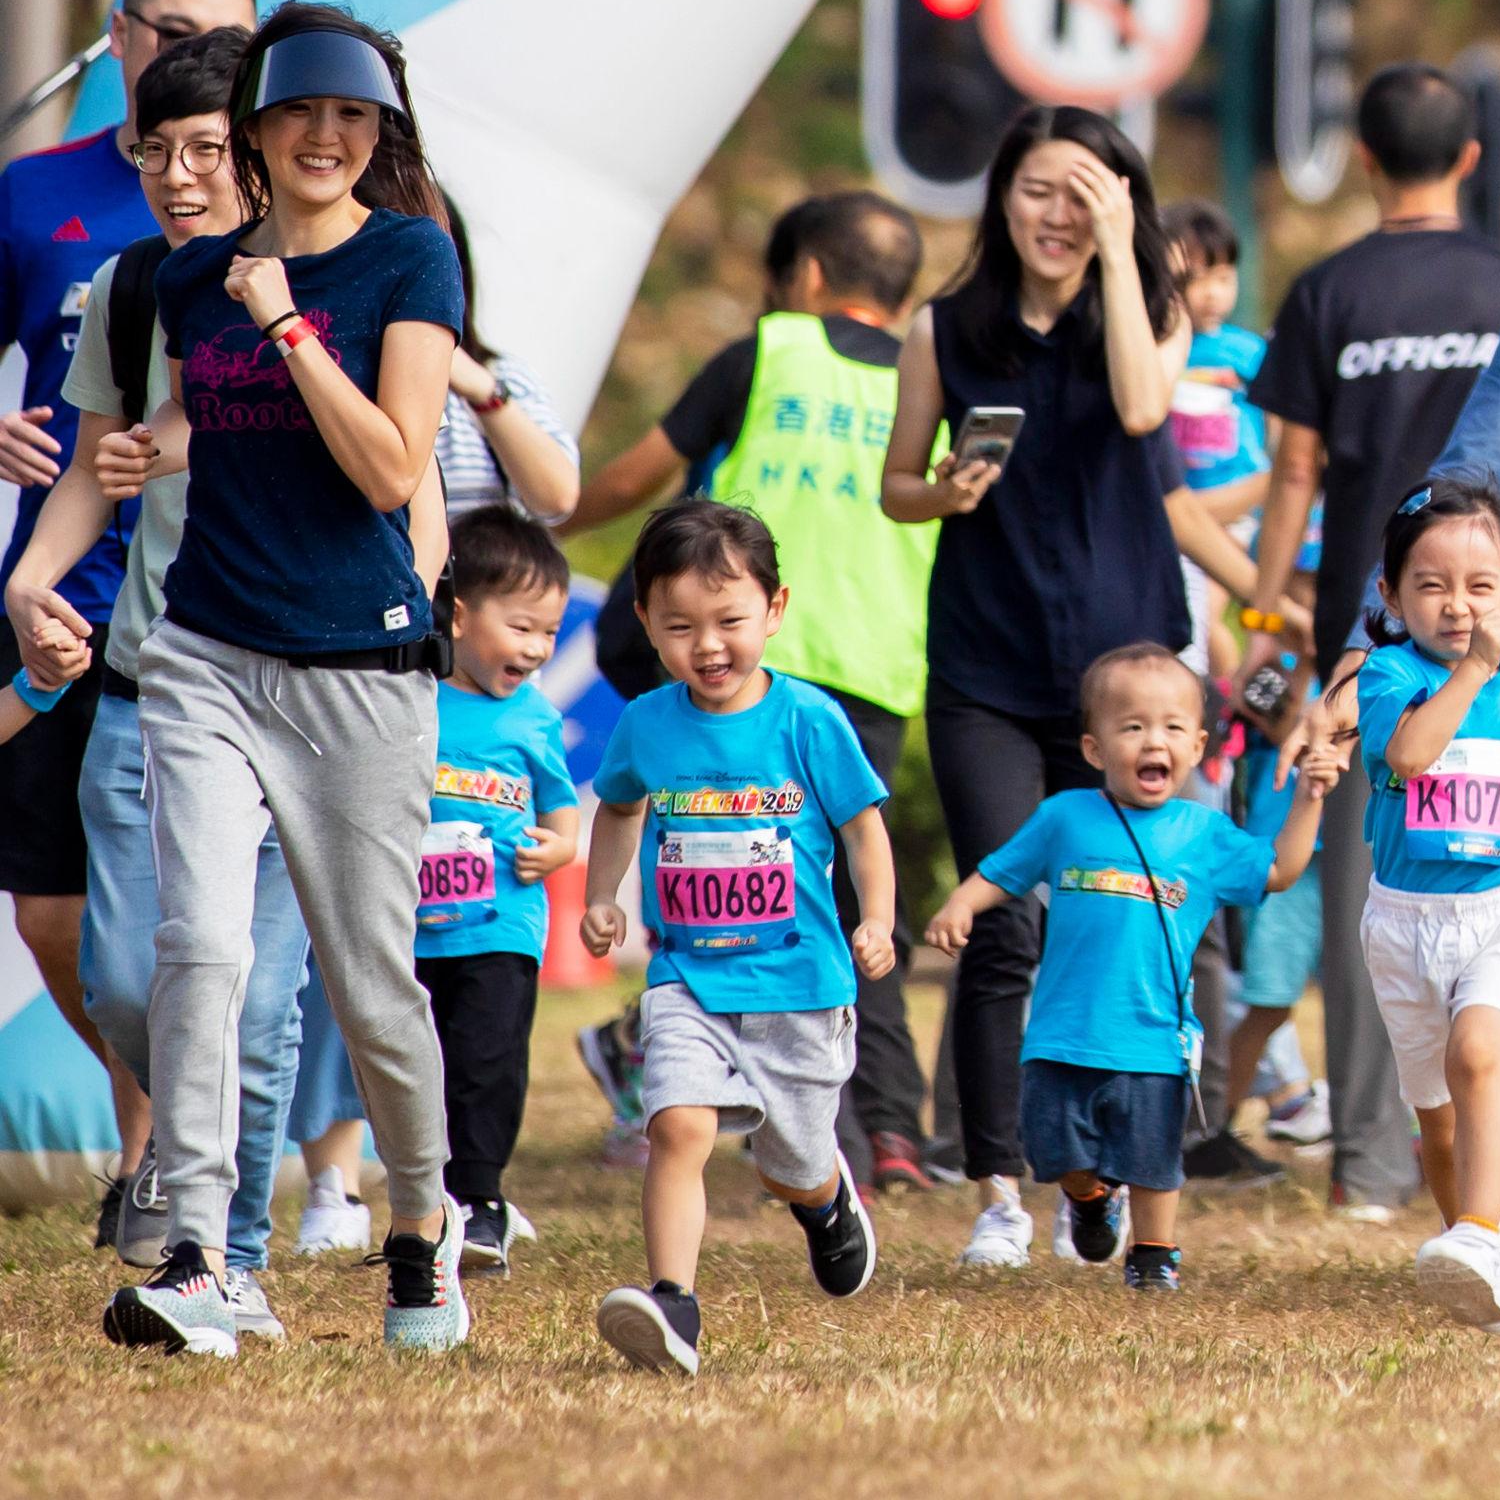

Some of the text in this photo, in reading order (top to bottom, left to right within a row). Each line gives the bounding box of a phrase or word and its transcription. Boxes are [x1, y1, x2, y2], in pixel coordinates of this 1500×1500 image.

[759, 459, 884, 505] HKA
[673, 785, 760, 815] WEEKEND
[761, 782, 804, 815] 2019
[419, 857, 487, 899] 0859
[662, 869, 788, 920] K10682
